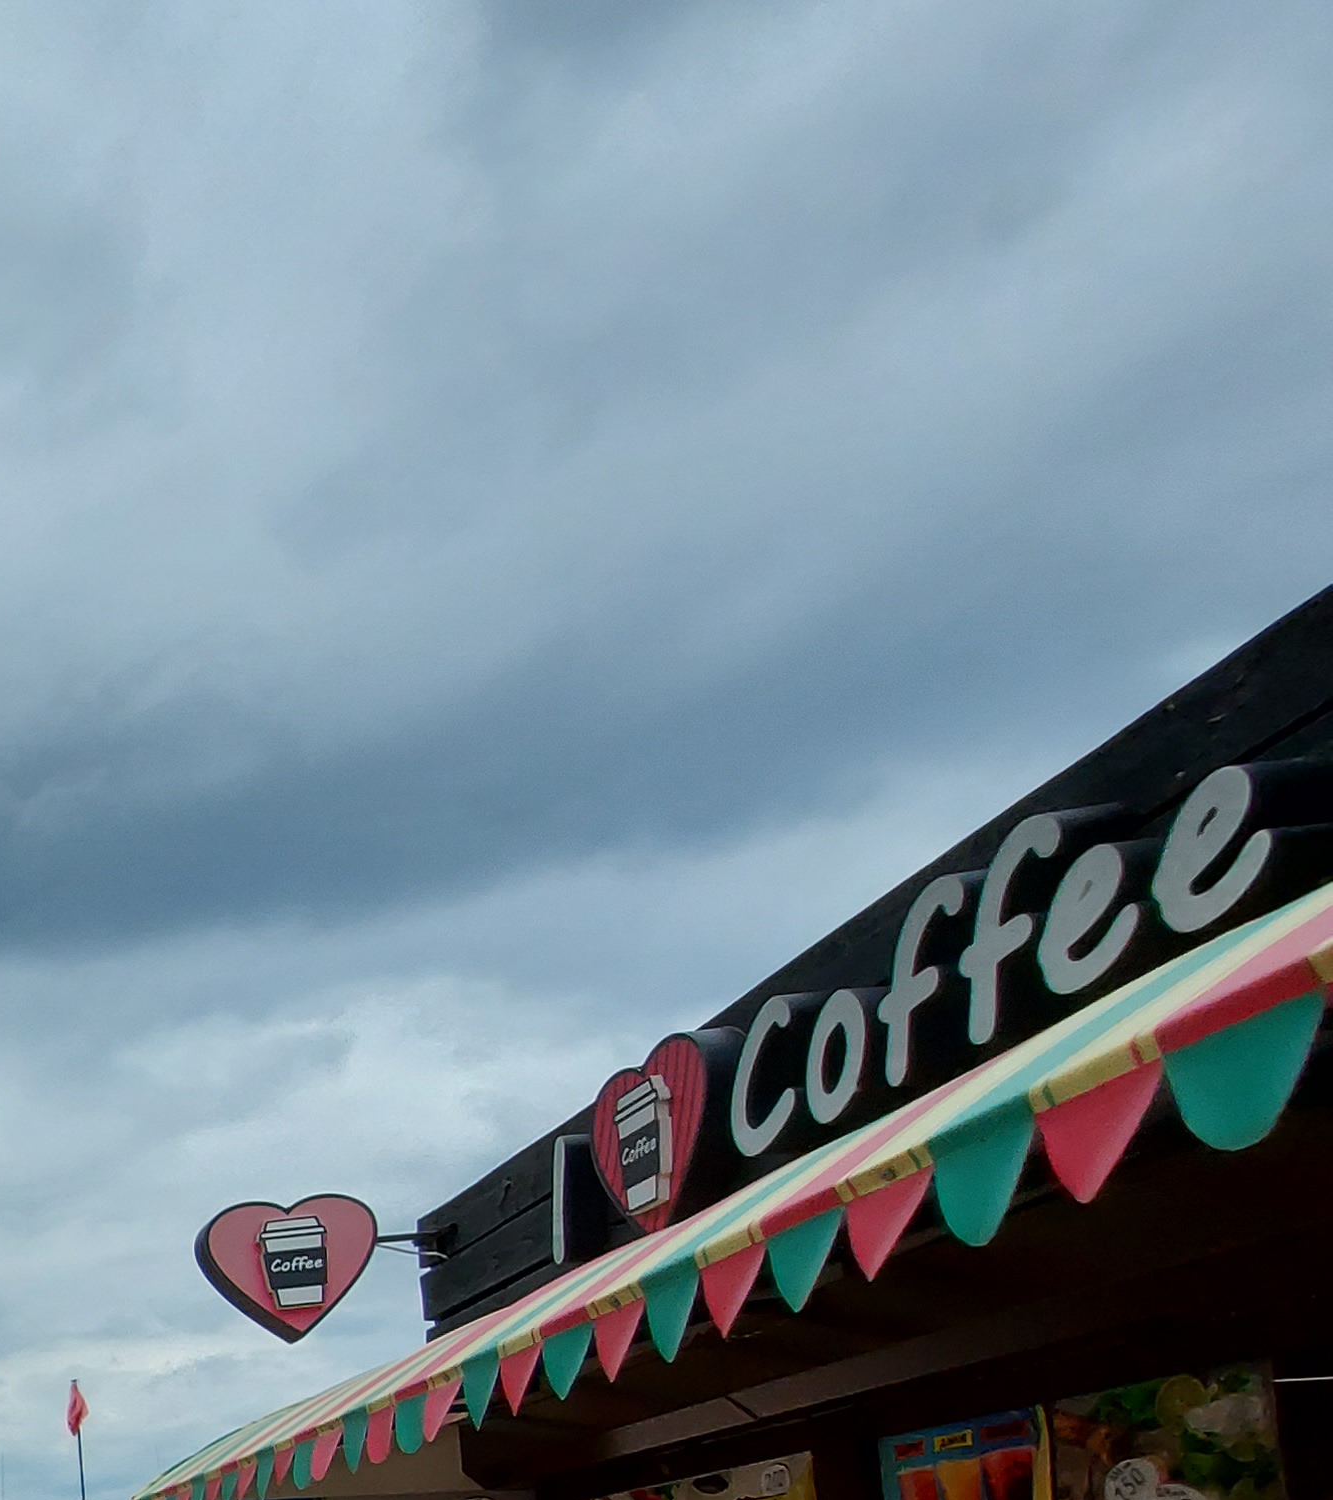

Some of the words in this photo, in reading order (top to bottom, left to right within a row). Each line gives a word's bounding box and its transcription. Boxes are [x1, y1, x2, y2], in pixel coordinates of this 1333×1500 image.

[732, 765, 1272, 1156] Coffee
[621, 1136, 657, 1165] Coffee
[271, 1256, 323, 1272] Coffee
